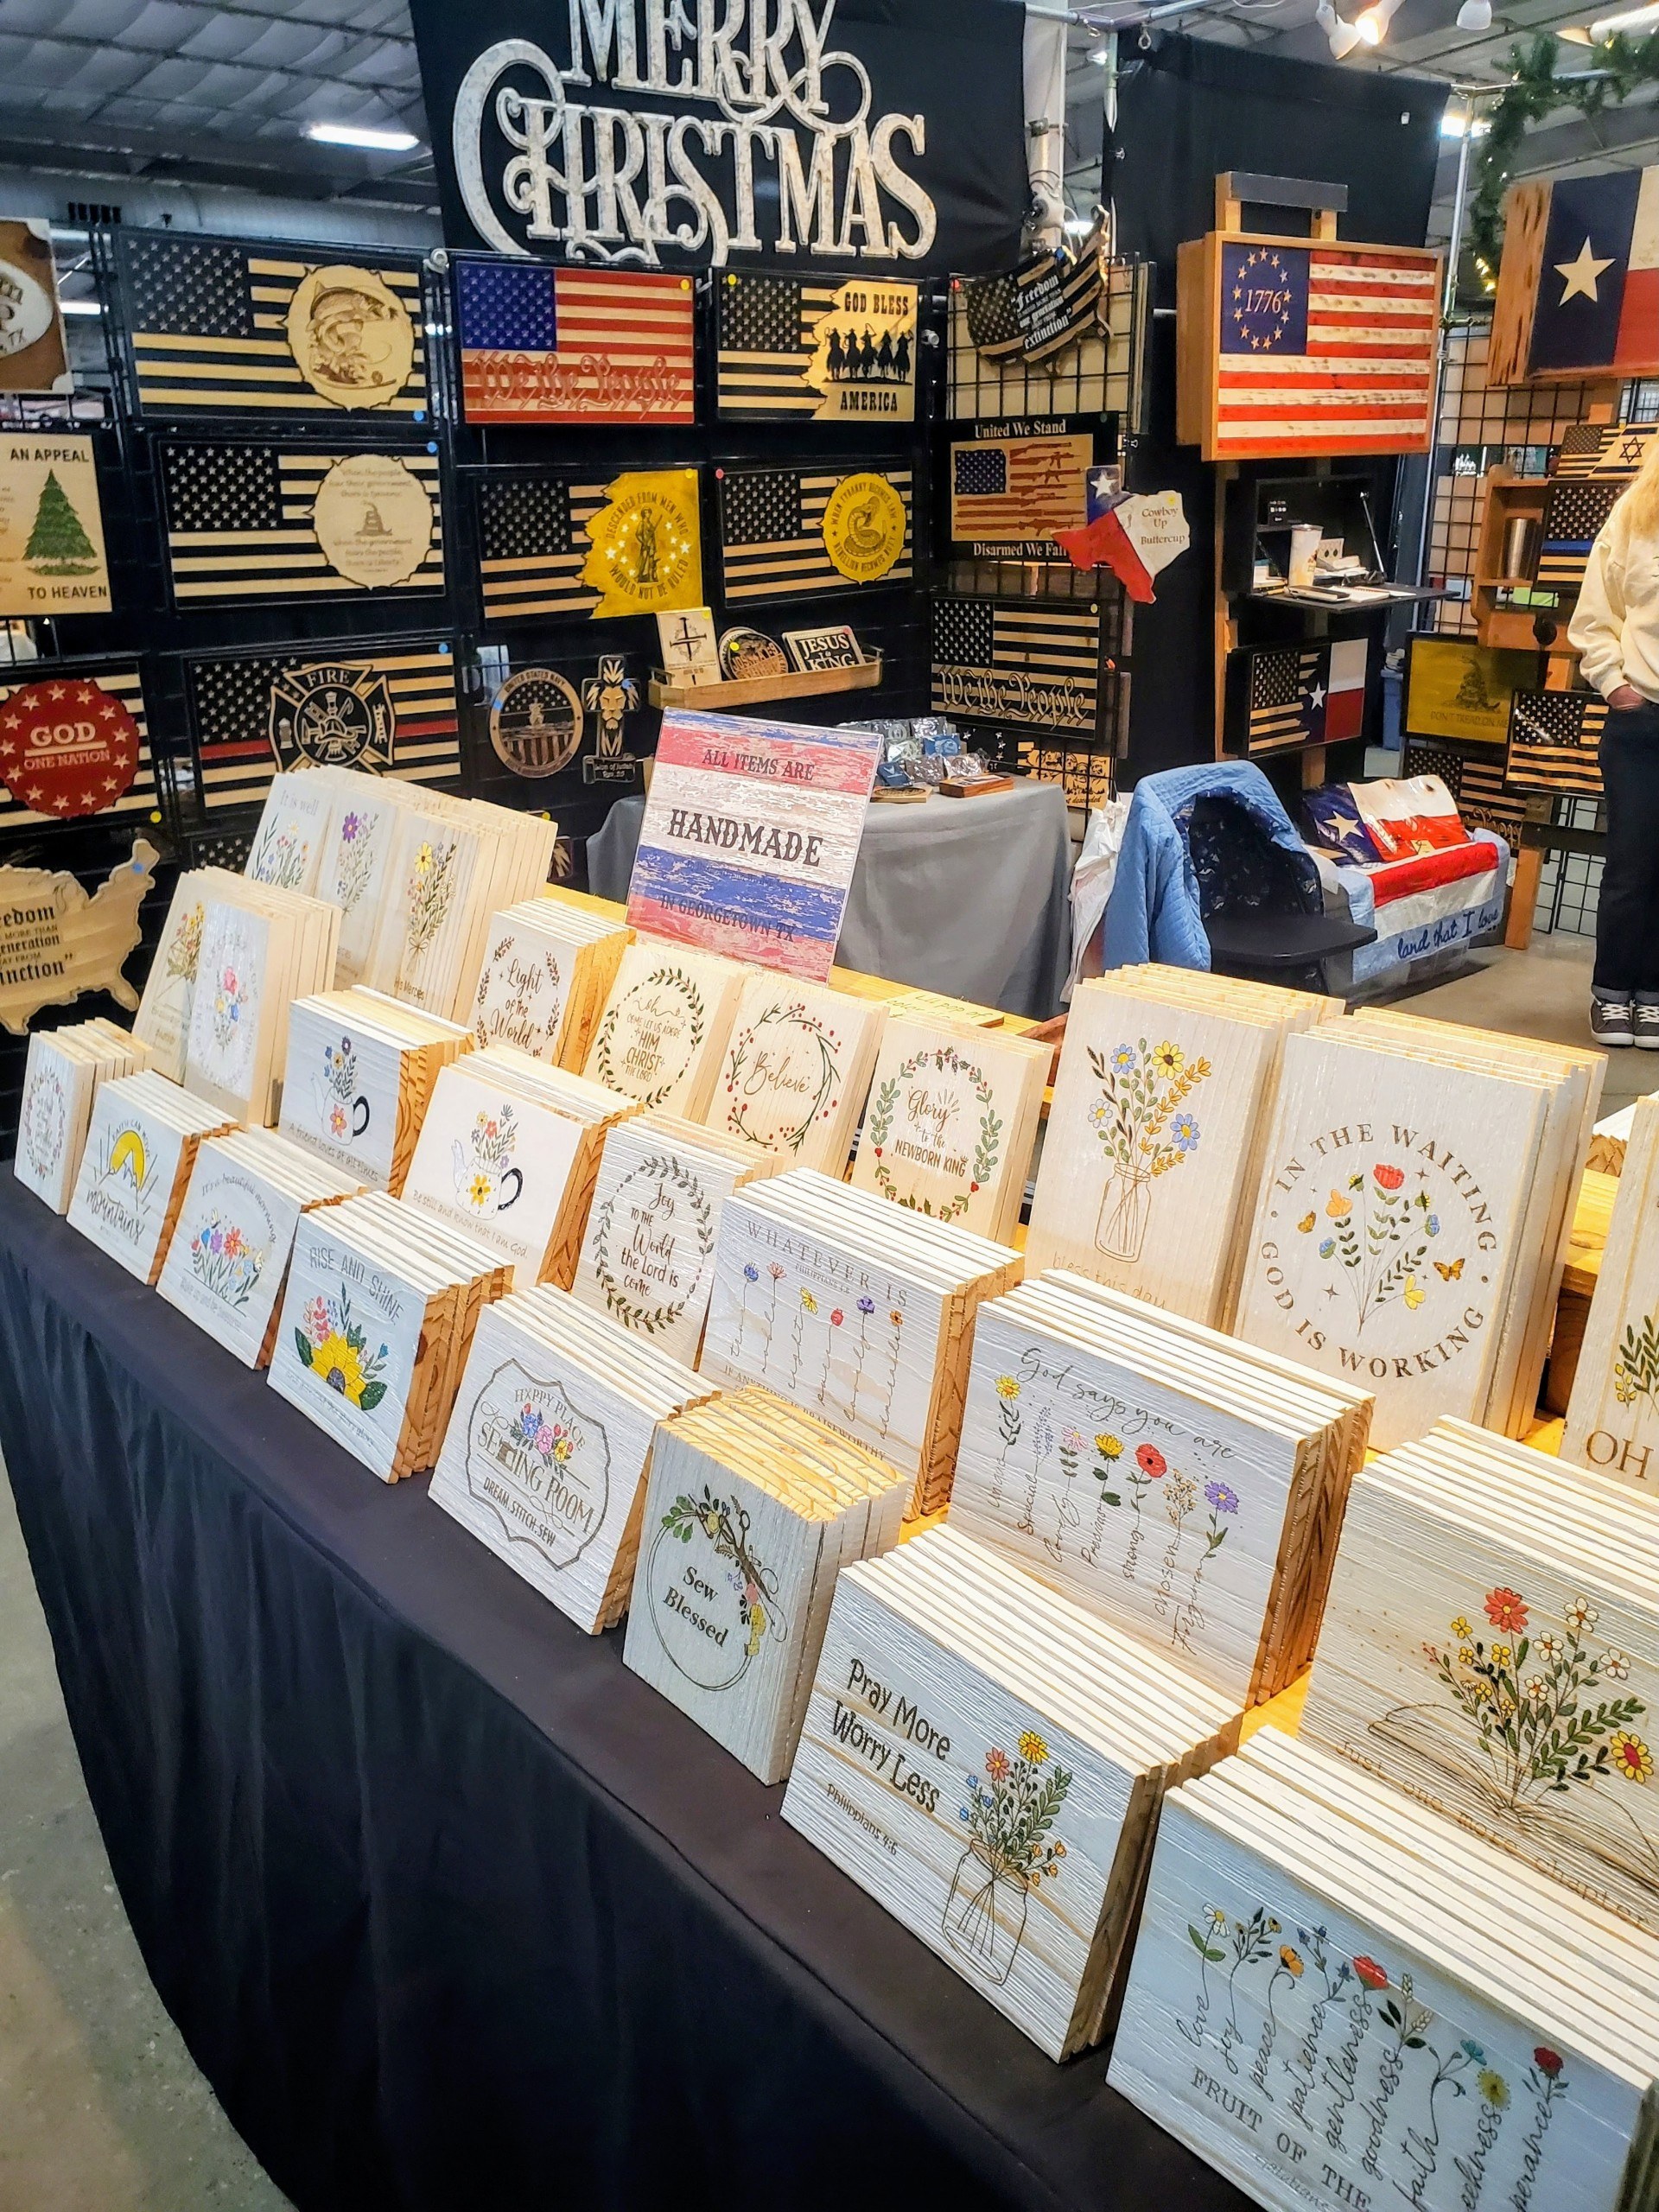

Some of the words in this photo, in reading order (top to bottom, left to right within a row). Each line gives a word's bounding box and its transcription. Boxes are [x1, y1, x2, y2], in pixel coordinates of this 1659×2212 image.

[560, 0, 870, 130] MERRY
[453, 38, 937, 266] CHRISTMAS
[844, 291, 867, 312] GOD
[873, 294, 909, 315] BLESS
[1245, 289, 1282, 314] 1776
[576, 353, 687, 421] People
[840, 391, 899, 411] AMERICA
[975, 423, 1010, 439] United
[1012, 421, 1032, 436] We
[1033, 418, 1067, 434] Stand
[10, 448, 29, 461] AN
[34, 448, 90, 462] APPEAL
[606, 495, 636, 540] DESCENDED
[637, 491, 658, 504] FROM
[659, 494, 677, 515] MEN
[674, 512, 690, 536] WHO
[1141, 506, 1179, 519] Cowboy
[1153, 520, 1167, 530] Up
[973, 543, 1023, 557] Disarmed
[1026, 543, 1043, 556] We
[1140, 533, 1185, 545] Buttercup
[28, 586, 47, 600] TO
[52, 585, 108, 599] HEAVEN
[609, 563, 637, 596] WOULD
[638, 586, 654, 601] NOT
[657, 582, 669, 598] BE
[667, 558, 690, 589] RULED
[798, 633, 851, 660] JESUS
[804, 652, 857, 671] KING
[307, 668, 351, 688] FIRE
[938, 665, 977, 712] We
[1004, 673, 1089, 732] People
[29, 721, 96, 747] GOD
[1431, 710, 1455, 721] DON'T
[1457, 714, 1481, 724] TREAD
[1482, 716, 1495, 725] ON
[23, 756, 54, 771] ONE
[58, 749, 111, 767] NATION
[702, 748, 730, 767] ALL
[734, 753, 779, 776] ITEMS
[781, 760, 815, 781] ARE
[281, 789, 289, 806] It
[288, 796, 298, 812] is
[302, 799, 320, 817] well
[667, 809, 823, 868] HANDMADE
[0, 906, 55, 928] edom
[660, 893, 674, 912] IN
[678, 897, 775, 938] GEORGETOWN
[776, 921, 795, 943] TX
[1397, 929, 1431, 959] land
[1433, 920, 1459, 947] that
[1461, 910, 1476, 938] I
[1478, 907, 1498, 929] love
[507, 958, 544, 998] Light
[490, 1007, 535, 1050] World
[505, 999, 517, 1014] of
[516, 997, 529, 1019] the
[626, 1014, 643, 1027] COME
[643, 1018, 654, 1031] LET
[654, 1022, 662, 1033] US
[936, 1001, 966, 1014] pop
[626, 1046, 663, 1073] CHRIST
[638, 1031, 661, 1052] HIM
[625, 1065, 637, 1078] THE
[637, 1069, 653, 1083] LORD
[744, 1051, 810, 1096] Believe
[130, 1118, 143, 1131] CAN
[908, 1089, 951, 1134] Glory
[296, 1127, 317, 1145] friend
[318, 1138, 335, 1158] loves
[895, 1138, 942, 1169] NEWBORN
[943, 1154, 968, 1178] KING
[920, 1129, 931, 1142] to
[932, 1132, 947, 1149] the
[648, 1182, 675, 1222] Joy
[1274, 1156, 1306, 1194] IN
[1310, 1122, 1374, 1157] THE
[1391, 1124, 1497, 1253] WAITING
[86, 1189, 146, 1246] mountains
[254, 1192, 277, 1244] morning
[413, 1189, 422, 1205] Be
[423, 1194, 438, 1211] still
[437, 1205, 453, 1219] and
[454, 1211, 476, 1230] know
[475, 1221, 491, 1239] that
[495, 1234, 509, 1249] am
[510, 1242, 529, 1260] God.
[631, 1206, 639, 1221] TO
[640, 1211, 655, 1228] THE
[632, 1224, 676, 1266] World
[747, 1219, 871, 1292] WHATEVER
[885, 1281, 908, 1307] IS
[309, 1246, 336, 1269] RISE
[340, 1254, 365, 1284] AND
[368, 1274, 405, 1326] SHINE
[621, 1246, 640, 1271] the
[641, 1255, 668, 1283] Lord
[669, 1268, 681, 1288] is
[624, 1274, 653, 1298] come
[794, 1262, 839, 1290] PHILIPPIANS
[1052, 1250, 1090, 1279] bless
[1095, 1270, 1126, 1294] this
[1134, 1284, 1166, 1310] day
[1261, 1241, 1294, 1311] GOD
[1294, 1317, 1327, 1351] IS
[1338, 1306, 1484, 1379] WORKING
[1016, 1346, 1074, 1391] God
[1072, 1382, 1127, 1422] says
[1121, 1406, 1187, 1435] you
[1192, 1434, 1237, 1459] are
[554, 1400, 587, 1452] PLACE
[1586, 1431, 1655, 1481] OH
[544, 1475, 595, 1535] ROOM
[683, 1566, 719, 1603] Sew
[662, 1586, 728, 1648] Blessed
[847, 1658, 893, 1714] Pray
[893, 1695, 950, 1761] More
[833, 1700, 891, 1771] Worry
[889, 1753, 939, 1814] Less
[1335, 1741, 1387, 1780] Just
[1402, 1780, 1444, 1812] one
[827, 1783, 881, 1840] Philippians
[882, 1833, 899, 1856] 4:6
[1176, 1994, 1210, 2048] love
[1214, 2017, 1244, 2075] joy
[1249, 2020, 1277, 2102] peace
[1282, 2002, 1327, 2133] patience
[1321, 1993, 1373, 2155] gentleness
[1360, 2045, 1404, 2182] goodness
[1191, 2067, 1263, 2133] FRUIT
[1276, 2133, 1308, 2164] OF
[1320, 2164, 1372, 2212] THE
